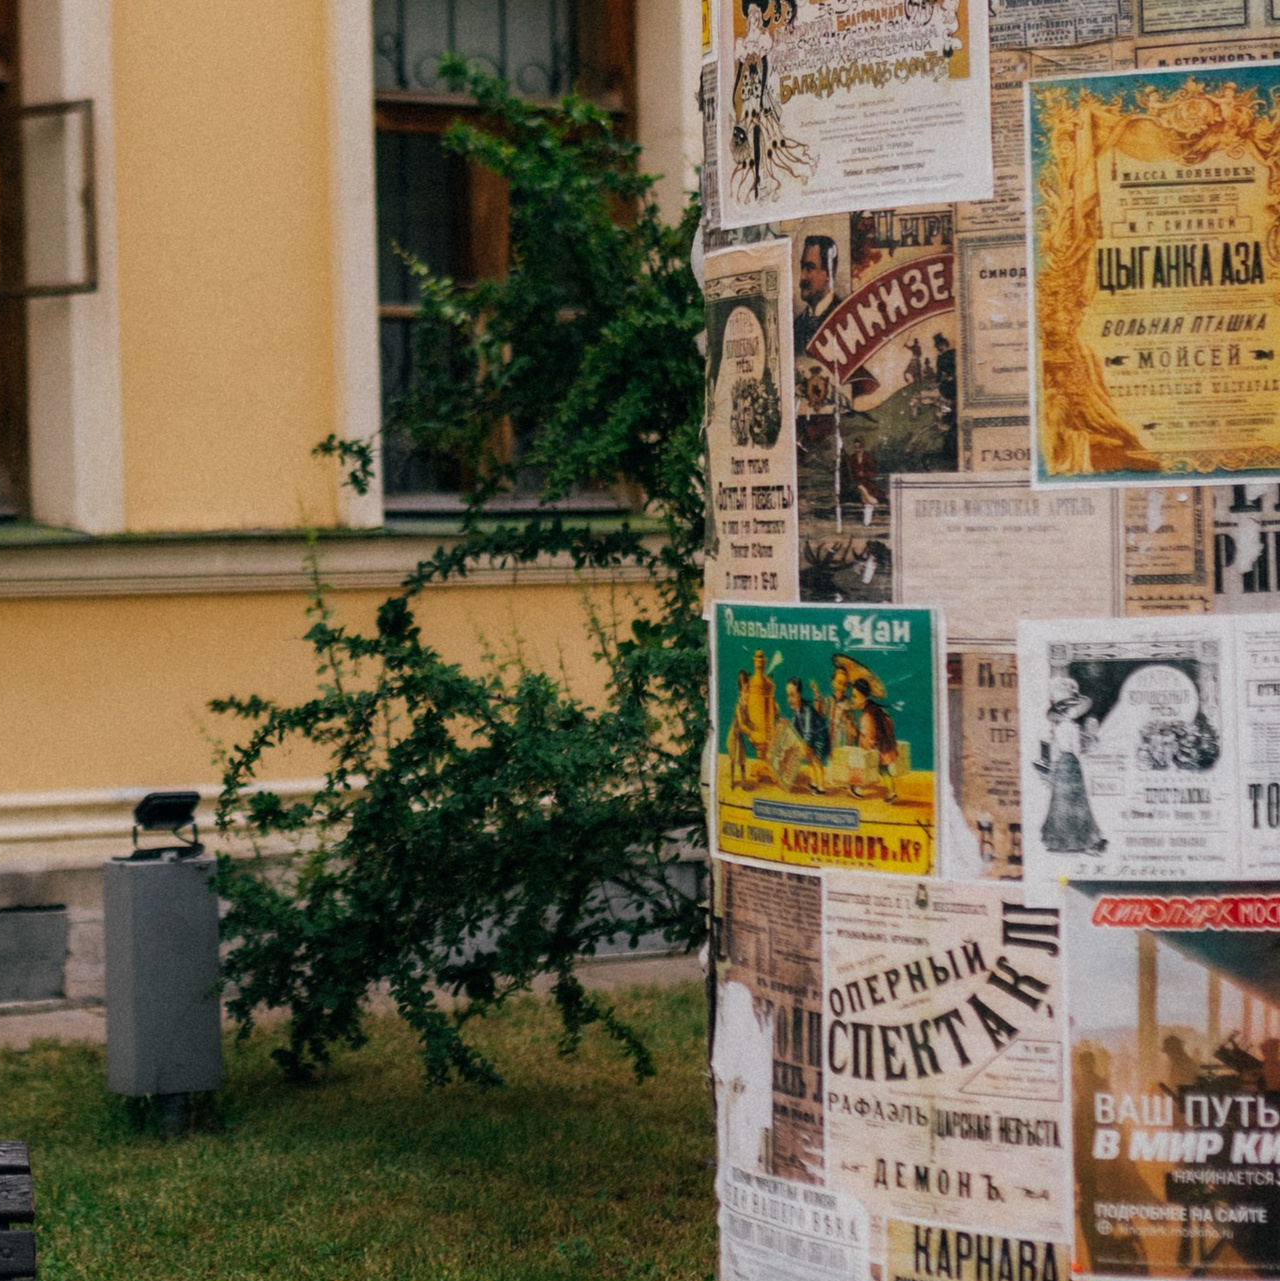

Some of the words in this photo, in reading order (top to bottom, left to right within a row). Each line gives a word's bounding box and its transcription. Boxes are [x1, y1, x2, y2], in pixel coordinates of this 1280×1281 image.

[1097, 244, 1214, 296] ЦЫГАНКА
[1220, 240, 1266, 286] АЗА
[814, 262, 955, 366] ЧИНИЗЕ
[1101, 317, 1185, 337] ВОЛЬНАЯ
[1190, 313, 1268, 333] ПТАШКА
[1096, 903, 1235, 924] КИНОПАРК
[829, 939, 987, 1018] ОПЕРНЫЙ
[828, 1091, 929, 1127] РАФАЭЛЬ
[1093, 1092, 1174, 1127] ВАШ
[1184, 1094, 1280, 1129] ПУТЬ
[1092, 1129, 1121, 1160] В
[1128, 1130, 1224, 1164] МИР
[1172, 1169, 1273, 1187] НАЧИНАЕТСЯ
[1094, 1202, 1187, 1222] ПОДРОБНЕЕ
[1189, 1206, 1213, 1222] НА
[1215, 1205, 1268, 1224] САЙТЕ
